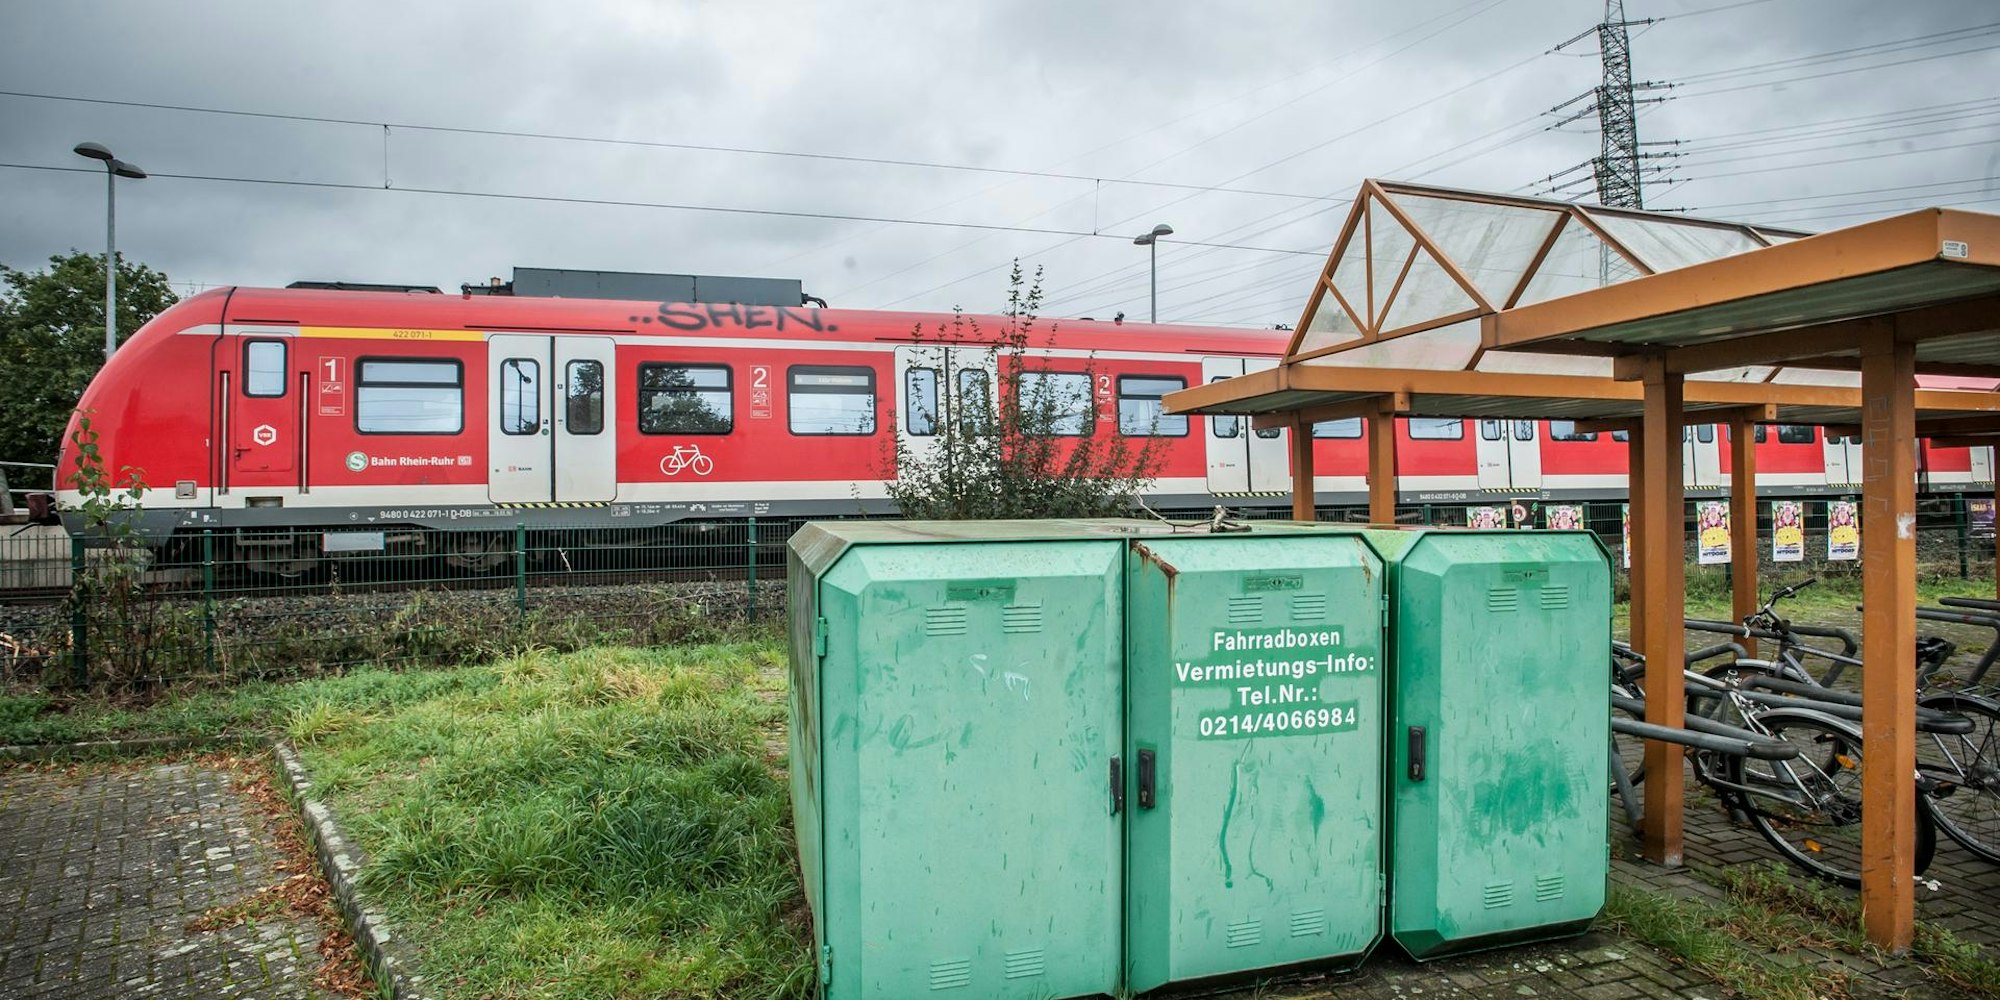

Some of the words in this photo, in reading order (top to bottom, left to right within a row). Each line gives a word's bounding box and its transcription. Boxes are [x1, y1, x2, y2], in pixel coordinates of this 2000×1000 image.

[393, 330, 409, 338] 422
[411, 331, 432, 339] 071-1
[325, 358, 336, 382] 1
[753, 367, 768, 389] 2
[1099, 375, 1111, 395] 2
[348, 453, 367, 471] S
[371, 456, 398, 466] Bahn
[400, 456, 455, 466] Rhein-Ruhr
[380, 510, 401, 519] 9480
[403, 510, 409, 518] 0
[410, 510, 426, 518] 422
[427, 509, 449, 518] 071-1
[451, 509, 472, 519] D-DB
[1214, 629, 1340, 651] Fahrradboxen
[1176, 653, 1374, 682] Vermietungs-Info:
[1237, 684, 1317, 706] Tel.Nr.:
[1200, 707, 1356, 737] 0214/4066984
